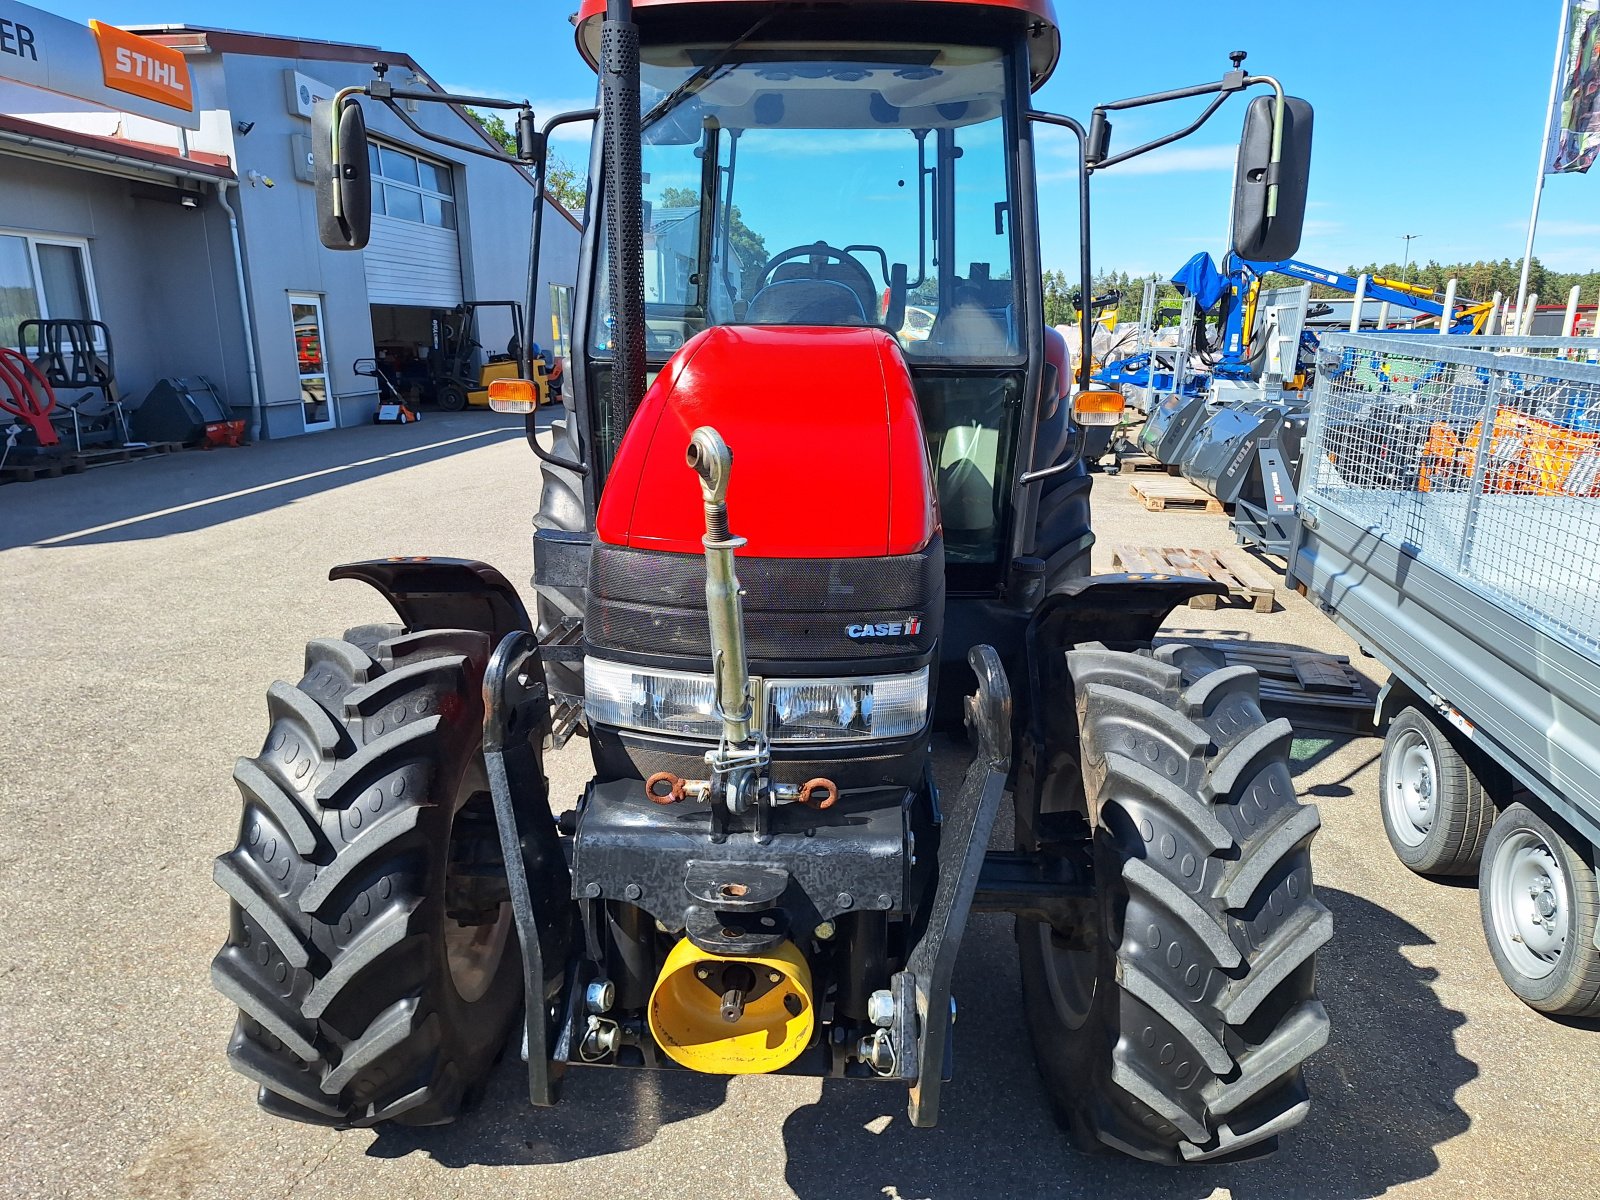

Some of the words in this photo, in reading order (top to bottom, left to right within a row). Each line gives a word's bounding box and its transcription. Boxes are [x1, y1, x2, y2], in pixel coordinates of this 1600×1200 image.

[115, 46, 184, 91] STIHL
[1226, 439, 1255, 478] STOLL
[848, 623, 902, 638] CASE
